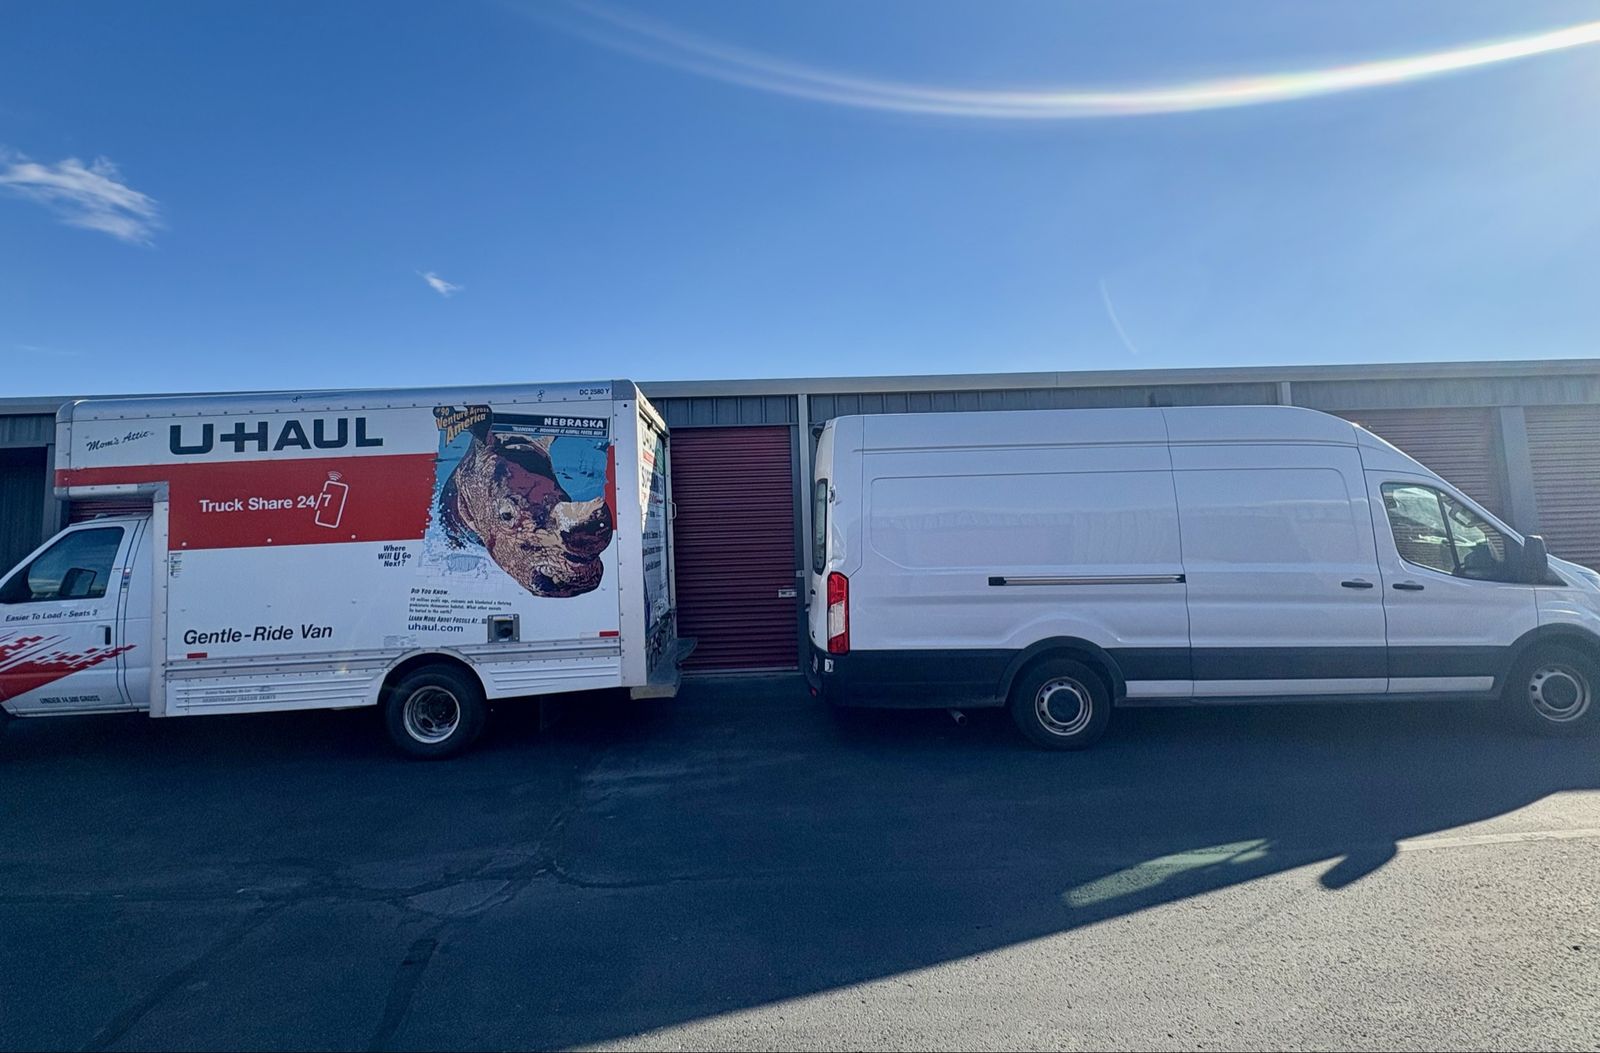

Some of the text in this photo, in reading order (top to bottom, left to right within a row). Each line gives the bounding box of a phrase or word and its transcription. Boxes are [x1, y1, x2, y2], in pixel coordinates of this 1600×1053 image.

[436, 409, 469, 429] Venture
[544, 417, 604, 429] NEBRASKA
[169, 417, 384, 455] U-HAUL
[446, 413, 486, 446] America
[86, 430, 151, 452] Mom's Attic
[199, 492, 332, 513] Truck Share 24/7
[377, 551, 411, 561] Will U Go
[383, 544, 406, 552] Where
[5, 614, 29, 622] Easier
[42, 611, 62, 619] Load
[68, 609, 90, 618] Seats
[92, 608, 98, 616] 3
[183, 623, 333, 645] Gentle-Ride Van
[408, 622, 464, 633] uhaul.com
